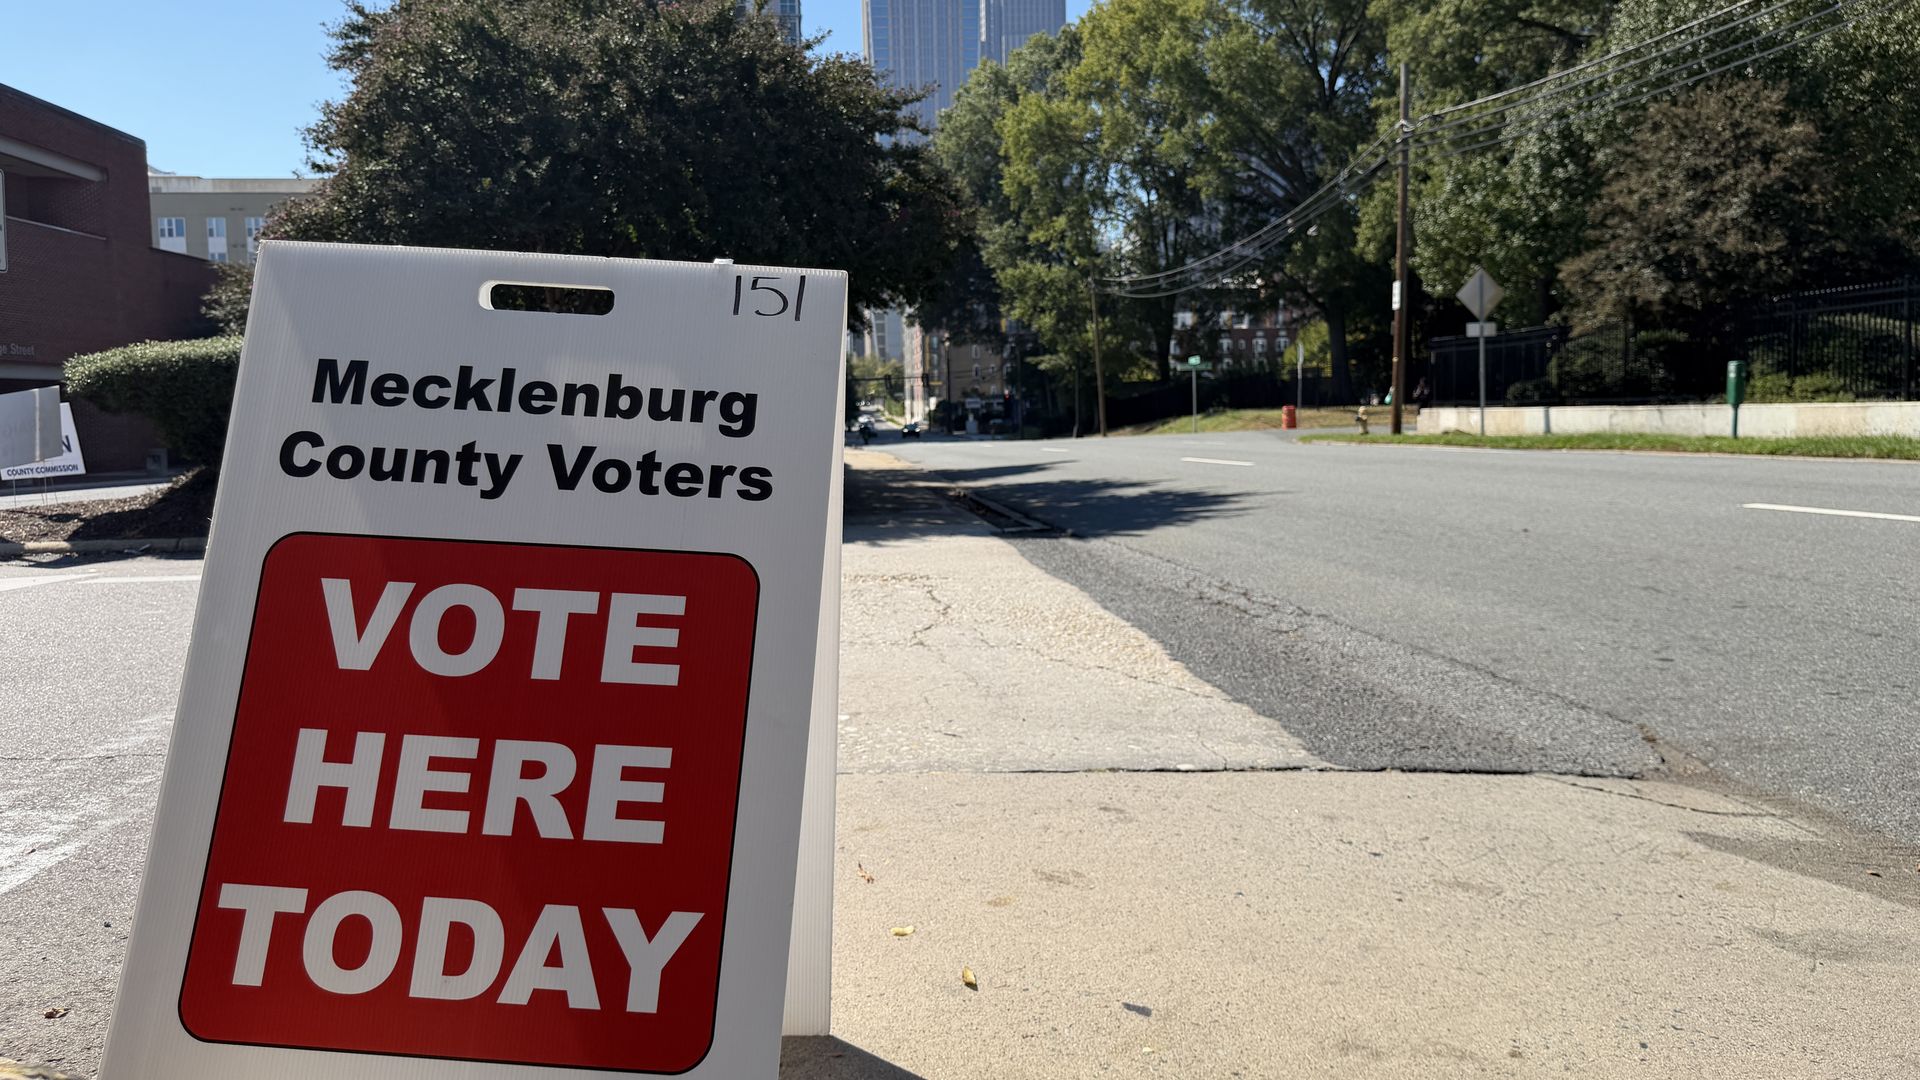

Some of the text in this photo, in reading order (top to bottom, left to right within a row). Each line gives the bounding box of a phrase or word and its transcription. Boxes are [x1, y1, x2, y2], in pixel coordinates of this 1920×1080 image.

[732, 275, 806, 322] 151
[311, 358, 759, 438] Mecklenburg
[6, 463, 79, 477] COUNTY COMMISSION
[279, 430, 774, 502] County Voters
[320, 577, 687, 687] VOTE
[283, 727, 673, 844] HERE
[217, 882, 706, 1014] TODAY
